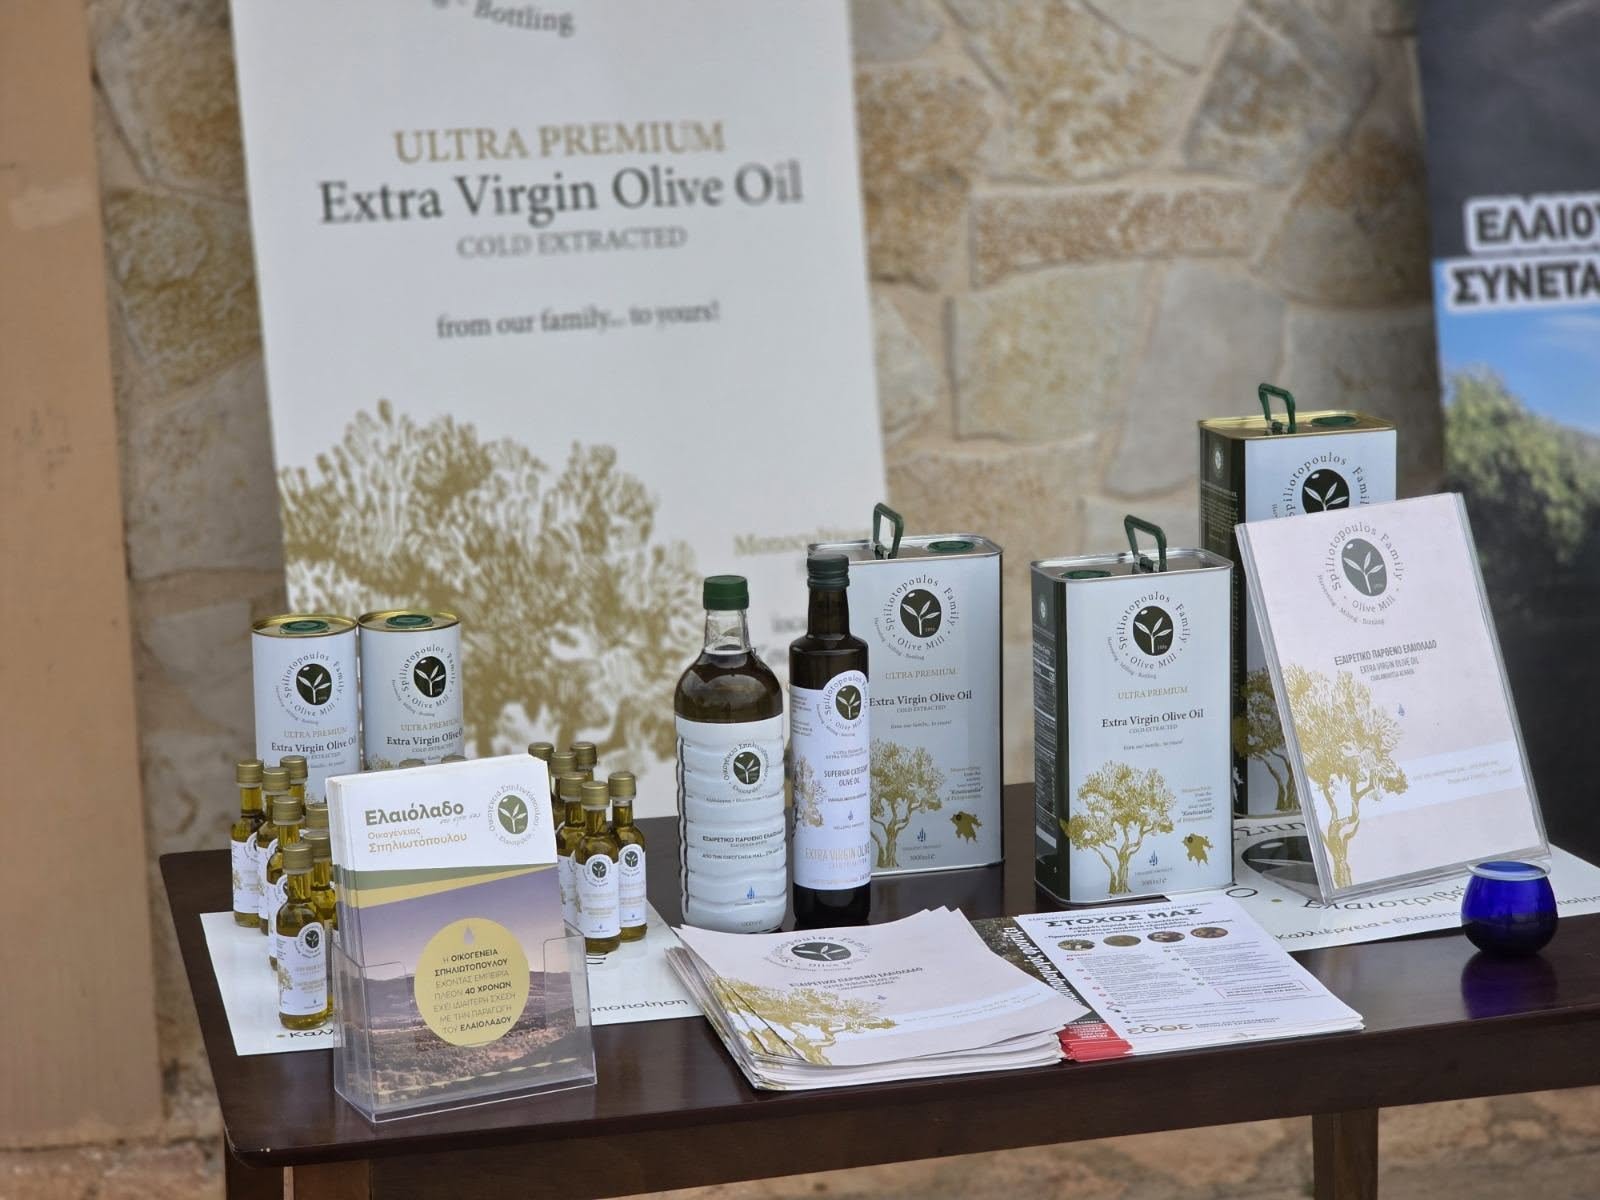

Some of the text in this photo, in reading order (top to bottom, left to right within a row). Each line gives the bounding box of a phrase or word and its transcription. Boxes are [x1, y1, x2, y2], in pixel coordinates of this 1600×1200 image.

[473, 0, 574, 38] Bottling
[394, 121, 725, 164] ULTRA PREMIUM
[319, 160, 804, 228] Extra Virgin Olive Oil
[1476, 202, 1600, 244] ΕΛΑΙΟ
[457, 227, 687, 260] COLD EXTRACTED
[437, 313, 491, 339] from
[496, 313, 536, 335] our
[629, 305, 652, 327] to
[656, 302, 721, 332] yours!
[1352, 466, 1370, 504] Famil
[1325, 521, 1405, 591] Spiliotopoulos Family
[882, 574, 960, 632] Spiliotopoulos Family
[1351, 595, 1397, 613] Olive Mill
[1116, 590, 1191, 651] Spiliotopoulos Family
[896, 634, 945, 651] Olive Mill
[398, 643, 445, 692] Spiliotopoulos
[1129, 653, 1177, 670] Olive Mill
[281, 651, 330, 699] Spiliotopoulos
[885, 667, 958, 680] ULTRA PREMIUM
[411, 697, 433, 709] Olive
[869, 689, 972, 707] Extra Virgin Olive Oil
[1118, 686, 1188, 700] ULTRA PREMIUM
[295, 702, 336, 717] Olive Mill
[1102, 708, 1204, 728] Extra Virgin Olive Oil
[284, 729, 311, 740] ULTRA
[386, 736, 411, 746] Extra
[412, 735, 440, 747] Virgin
[271, 742, 293, 753] Extra
[295, 743, 325, 755] Virgin
[326, 740, 347, 751] Olive
[823, 768, 850, 778] SUPERIOR
[364, 799, 464, 826] Ελαιόλαδο
[367, 827, 421, 840] Οικογένειας
[368, 832, 468, 853] Σπηλιωτόπουλου
[1045, 913, 1143, 928] ΣΤΟΧΟΣ
[1146, 908, 1202, 919] ΜΑΣ
[1275, 920, 1384, 942] Καλλιέργεια
[451, 948, 498, 962] ΟΙΚΟΓΕΝΕΙΑ
[434, 958, 508, 977] ΣΠΗΛΙΩΤΟΠΟΥΛΟΥ
[435, 969, 510, 988] ΕΧΟΝΤΑΣ ΕΜΠΕΙΡΙΑ
[434, 980, 512, 1001] ΠΛΕΟΝ 40 ΧΡΟΝΩΝ
[433, 1002, 453, 1013] ΕΧΕΙ
[439, 1013, 453, 1024] ΜΕ
[453, 1010, 471, 1021] ΤΗΝ
[442, 1015, 513, 1035] ΤΟΥ ΕΛΑΙΟΛΑΔΟΥ
